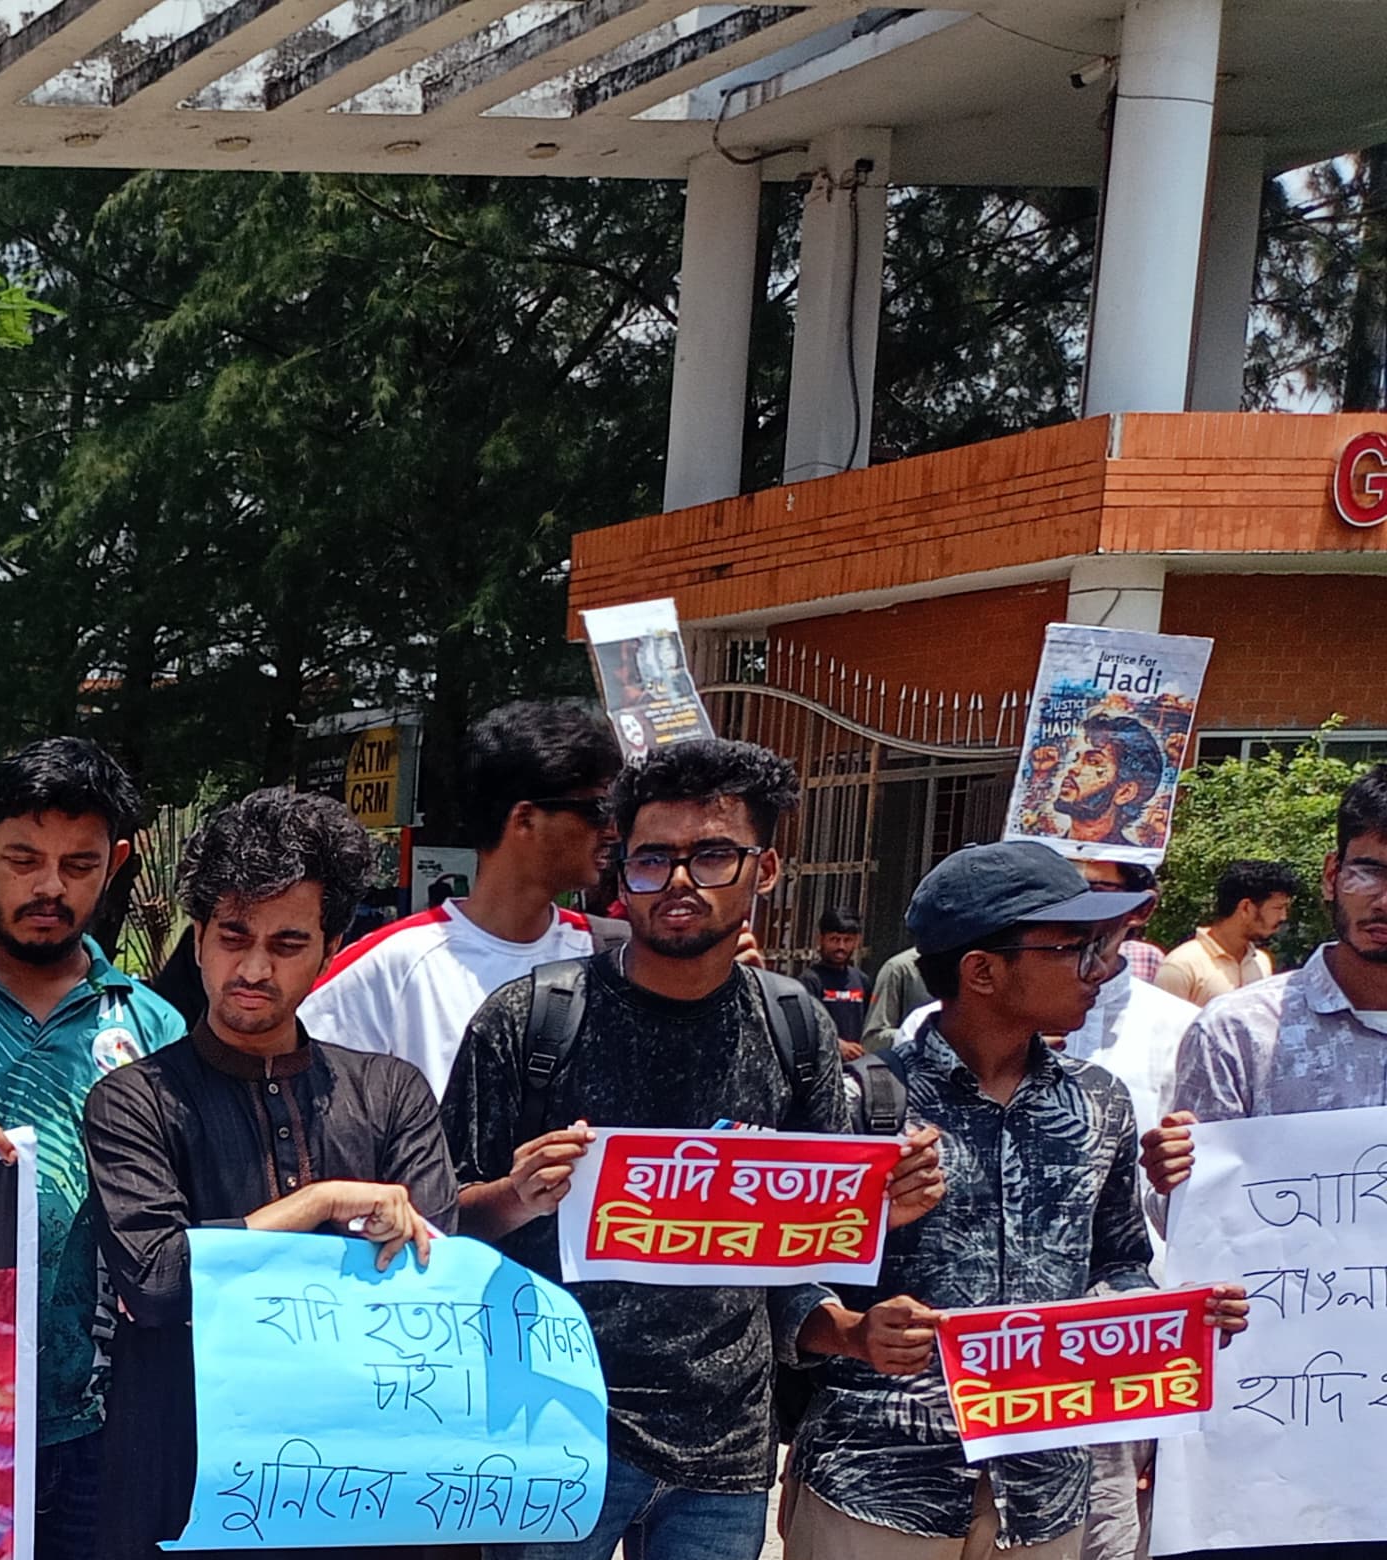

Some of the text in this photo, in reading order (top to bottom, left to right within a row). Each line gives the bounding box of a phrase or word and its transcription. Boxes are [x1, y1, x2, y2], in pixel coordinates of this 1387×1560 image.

[1093, 662, 1163, 694] Hadi
[1098, 650, 1158, 667] Justice For
[354, 740, 390, 774] ATM
[350, 781, 389, 815] CRM
[623, 1140, 872, 1206] হাদি হত্যার
[594, 1201, 869, 1259] বিচার চাই
[255, 1283, 597, 1367] হাদি হত্যার বিচার
[957, 1309, 1189, 1377] হাদি হত্যার
[952, 1357, 1202, 1432] বিচার চাই
[1232, 1350, 1366, 1427] হাদি
[217, 1438, 408, 1540] খুনিদের
[520, 1446, 590, 1537] চাই
